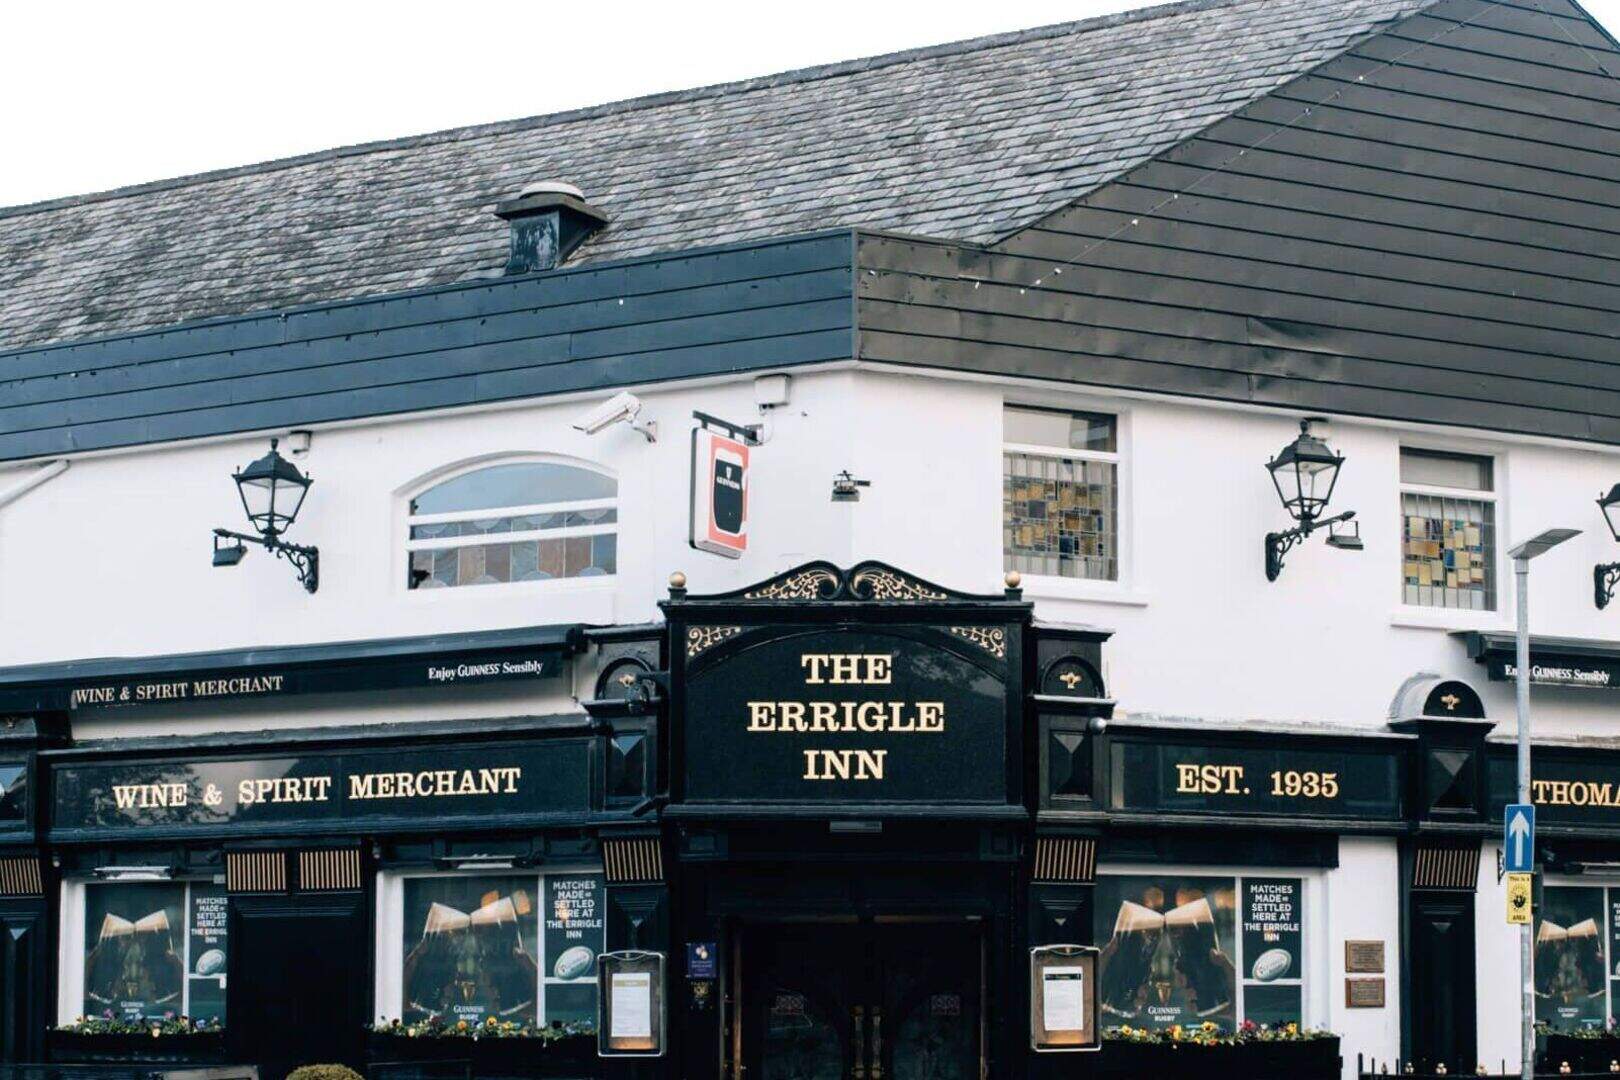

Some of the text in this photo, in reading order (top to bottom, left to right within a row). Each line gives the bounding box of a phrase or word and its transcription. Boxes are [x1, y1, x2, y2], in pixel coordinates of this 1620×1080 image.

[428, 660, 543, 681] Enjoy GUINNESS Sensibly
[801, 653, 892, 685] THE
[1532, 664, 1572, 679] GUINNESS
[1573, 668, 1610, 684] Sensibly
[76, 675, 284, 704] WINE & SPIRIT MERCHANT
[746, 701, 945, 732] ERRIGLE
[803, 749, 888, 780] INN
[1175, 764, 1339, 798] EST. 1935
[112, 767, 521, 809] WINE & SPIRIT MERCHANT
[553, 881, 596, 890] MATCHES
[1250, 884, 1293, 894] MATCHES
[558, 890, 584, 900] MADE
[1255, 894, 1281, 903] MADE
[554, 899, 595, 909] SETTLED
[1251, 903, 1292, 912] SETTLED
[555, 908, 594, 918] HERE AT
[1252, 912, 1292, 921] HERE AT
[546, 919, 603, 929] THE ERRIGLE
[1244, 923, 1299, 931] THE ERRIGLE
[566, 930, 582, 939] INN
